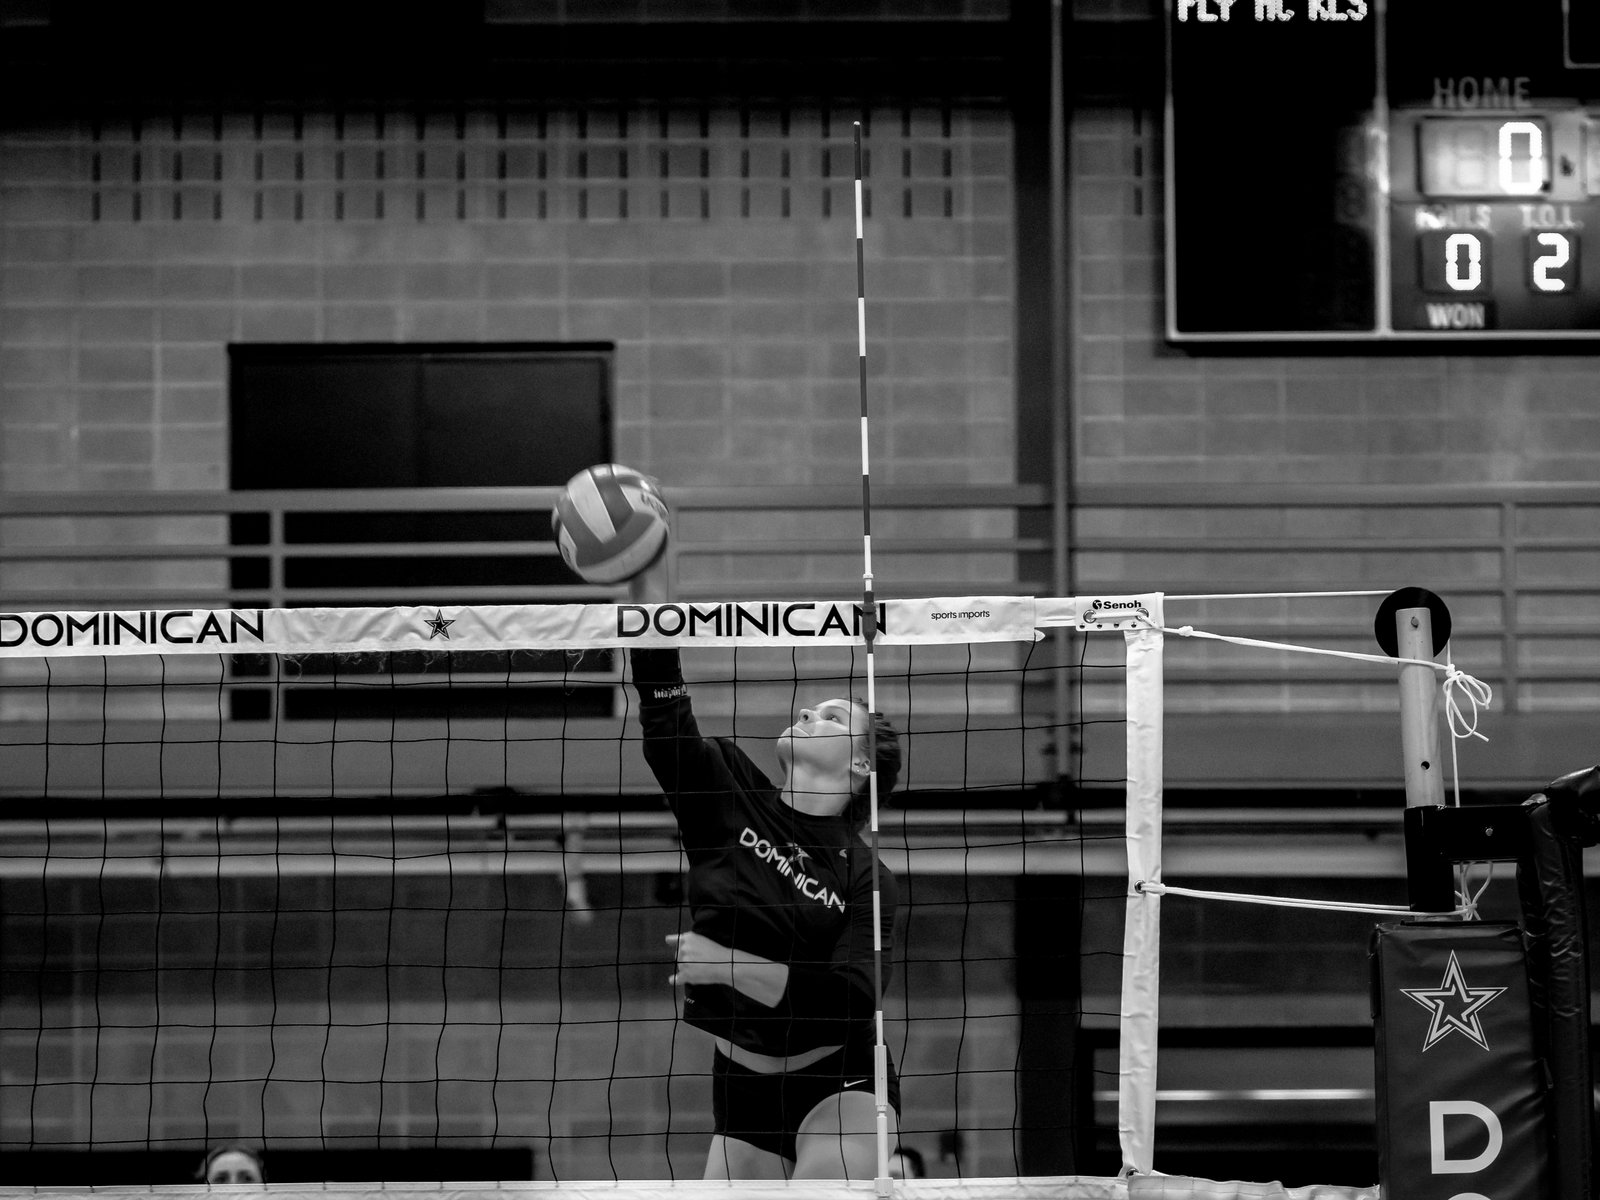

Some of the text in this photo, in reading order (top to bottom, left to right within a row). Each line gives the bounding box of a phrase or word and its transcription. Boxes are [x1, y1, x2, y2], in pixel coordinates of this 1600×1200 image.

[1432, 76, 1532, 108] HOME
[1499, 122, 1542, 195] 0
[1445, 232, 1570, 291] 0 2
[1425, 303, 1486, 329] WON
[617, 603, 887, 637] DOMINICAN
[931, 611, 957, 621] sports
[1103, 600, 1142, 610] Senoh
[0, 610, 264, 647] DOMINICAN
[739, 827, 847, 914] DOMINICAN
